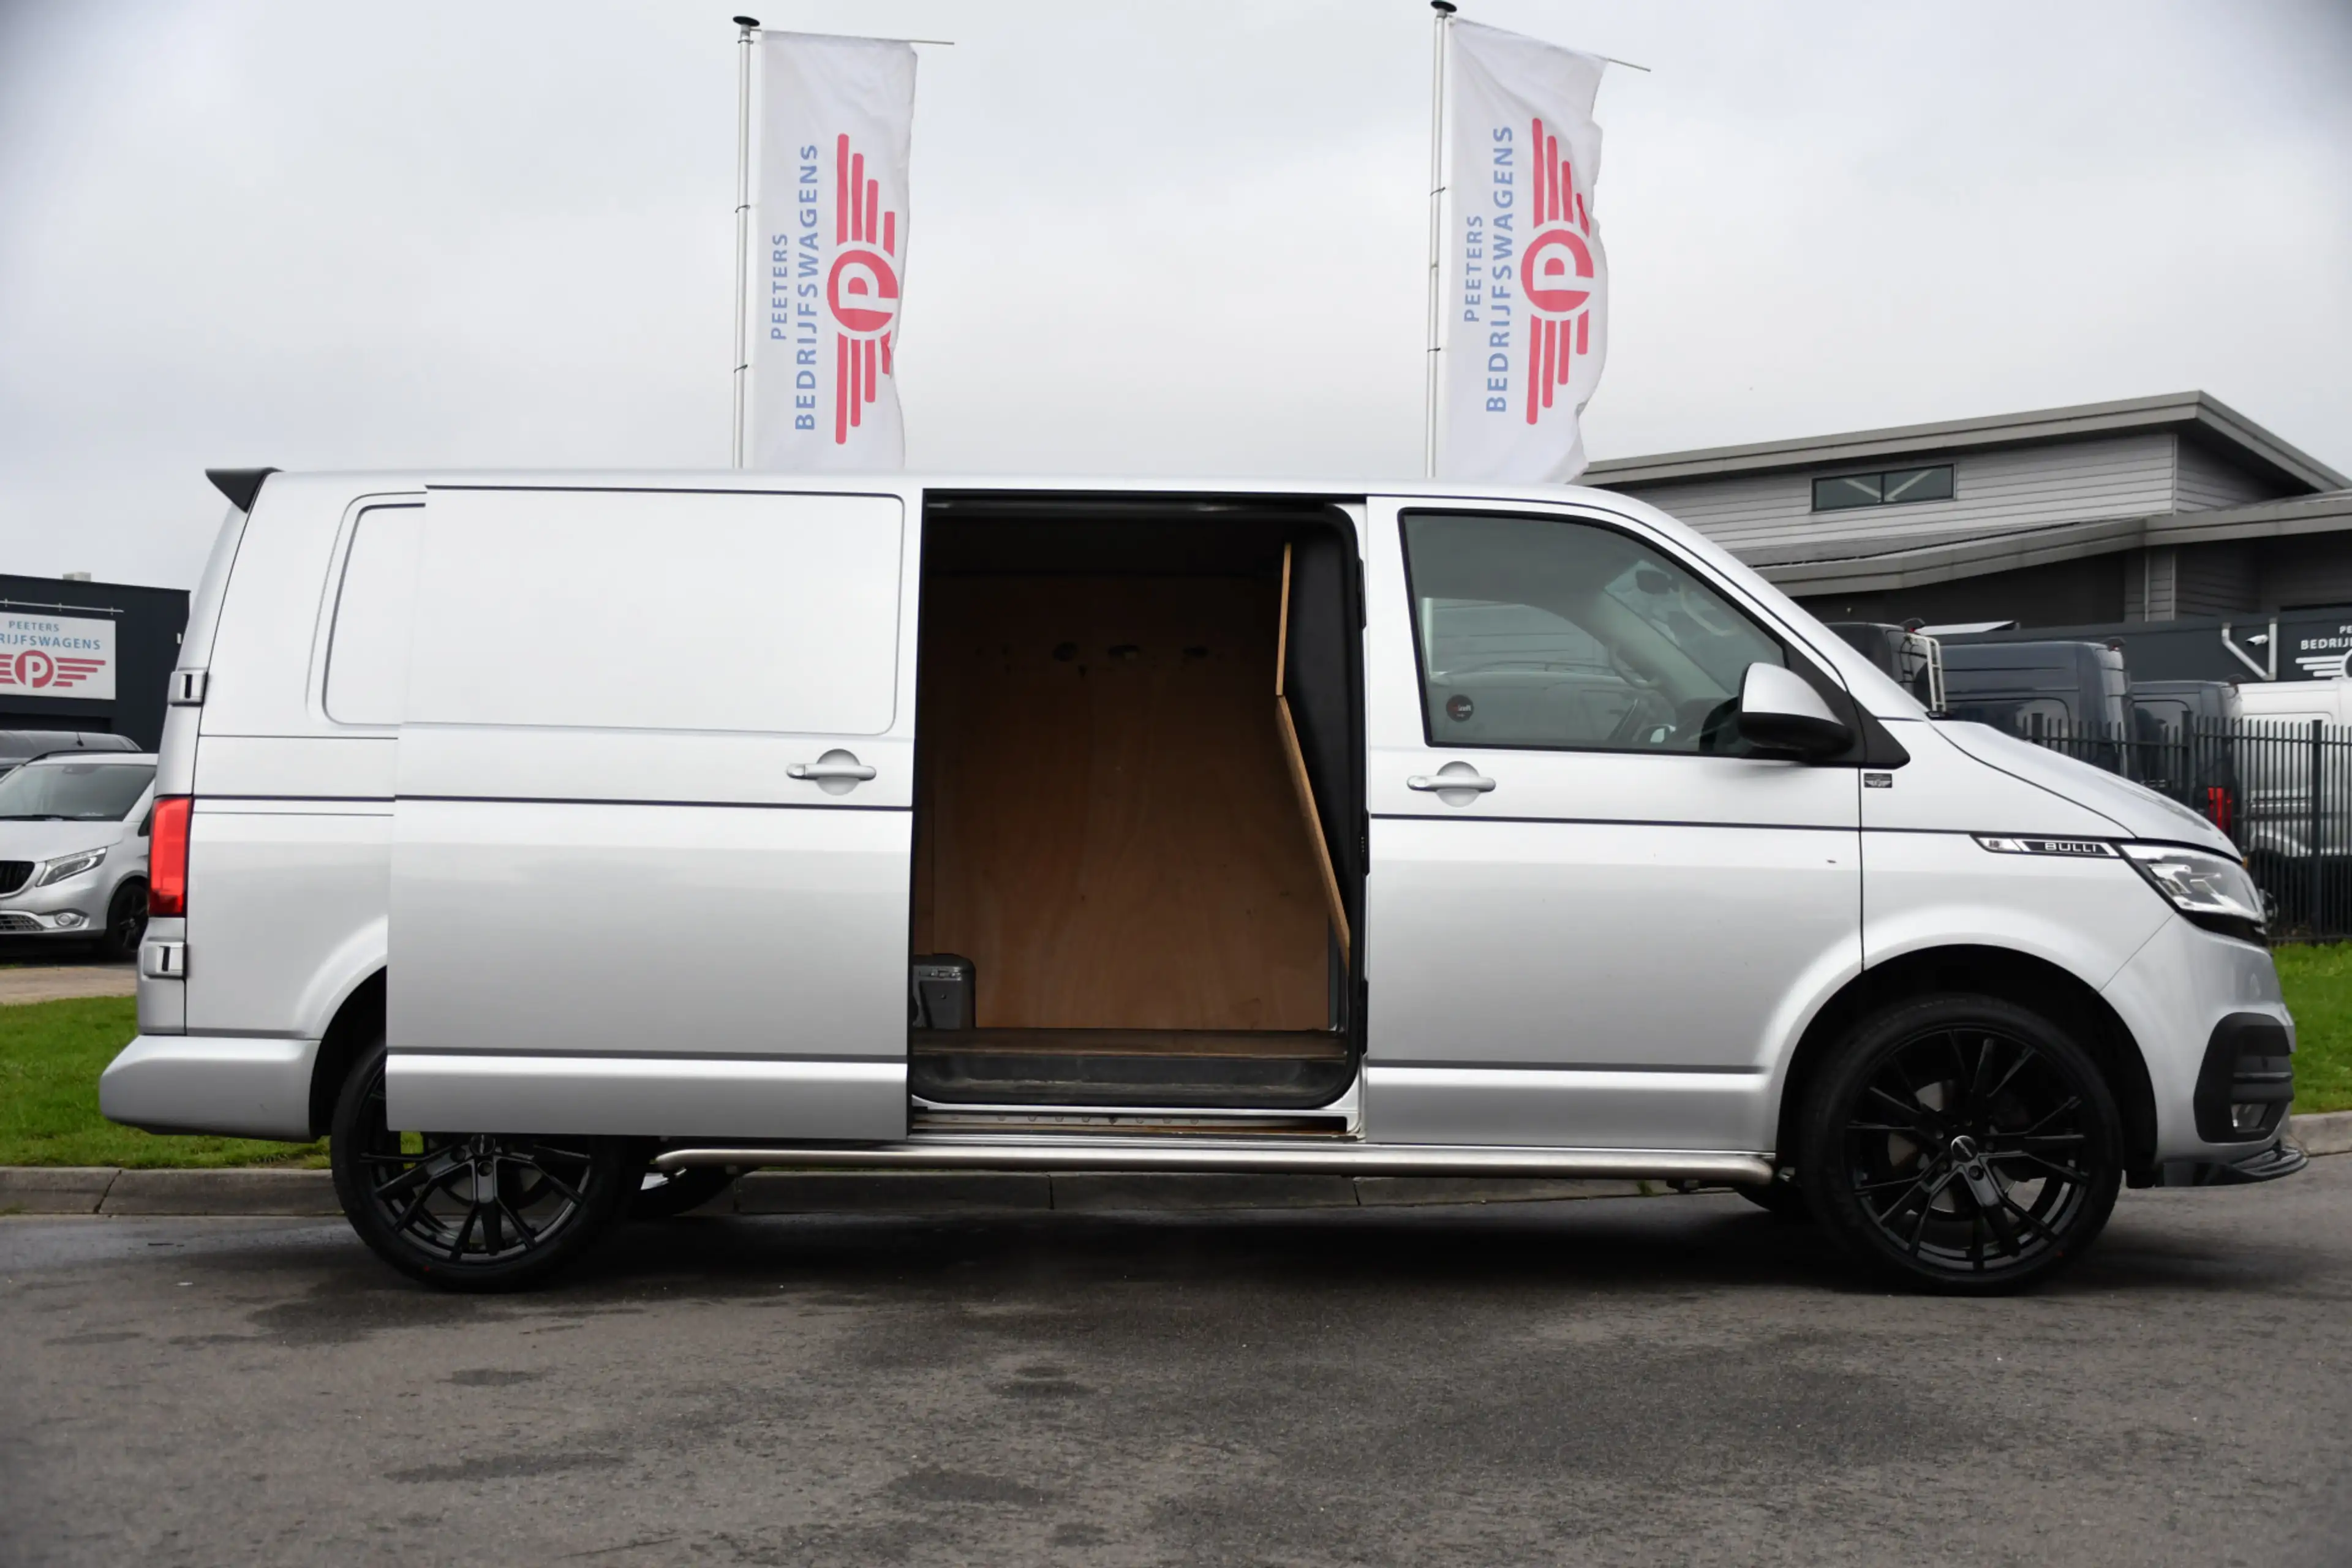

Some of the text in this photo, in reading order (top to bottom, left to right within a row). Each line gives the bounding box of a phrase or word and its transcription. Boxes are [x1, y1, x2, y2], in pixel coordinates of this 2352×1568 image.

[771, 234, 788, 341] PEETERS
[795, 144, 818, 431] BEDRIJFSWAGENS
[1464, 214, 1483, 322] PEETERS
[1486, 126, 1513, 413] BEDRIJFSWAGENS
[9, 620, 60, 631] PEETERS
[2045, 842, 2096, 853] BULLI
